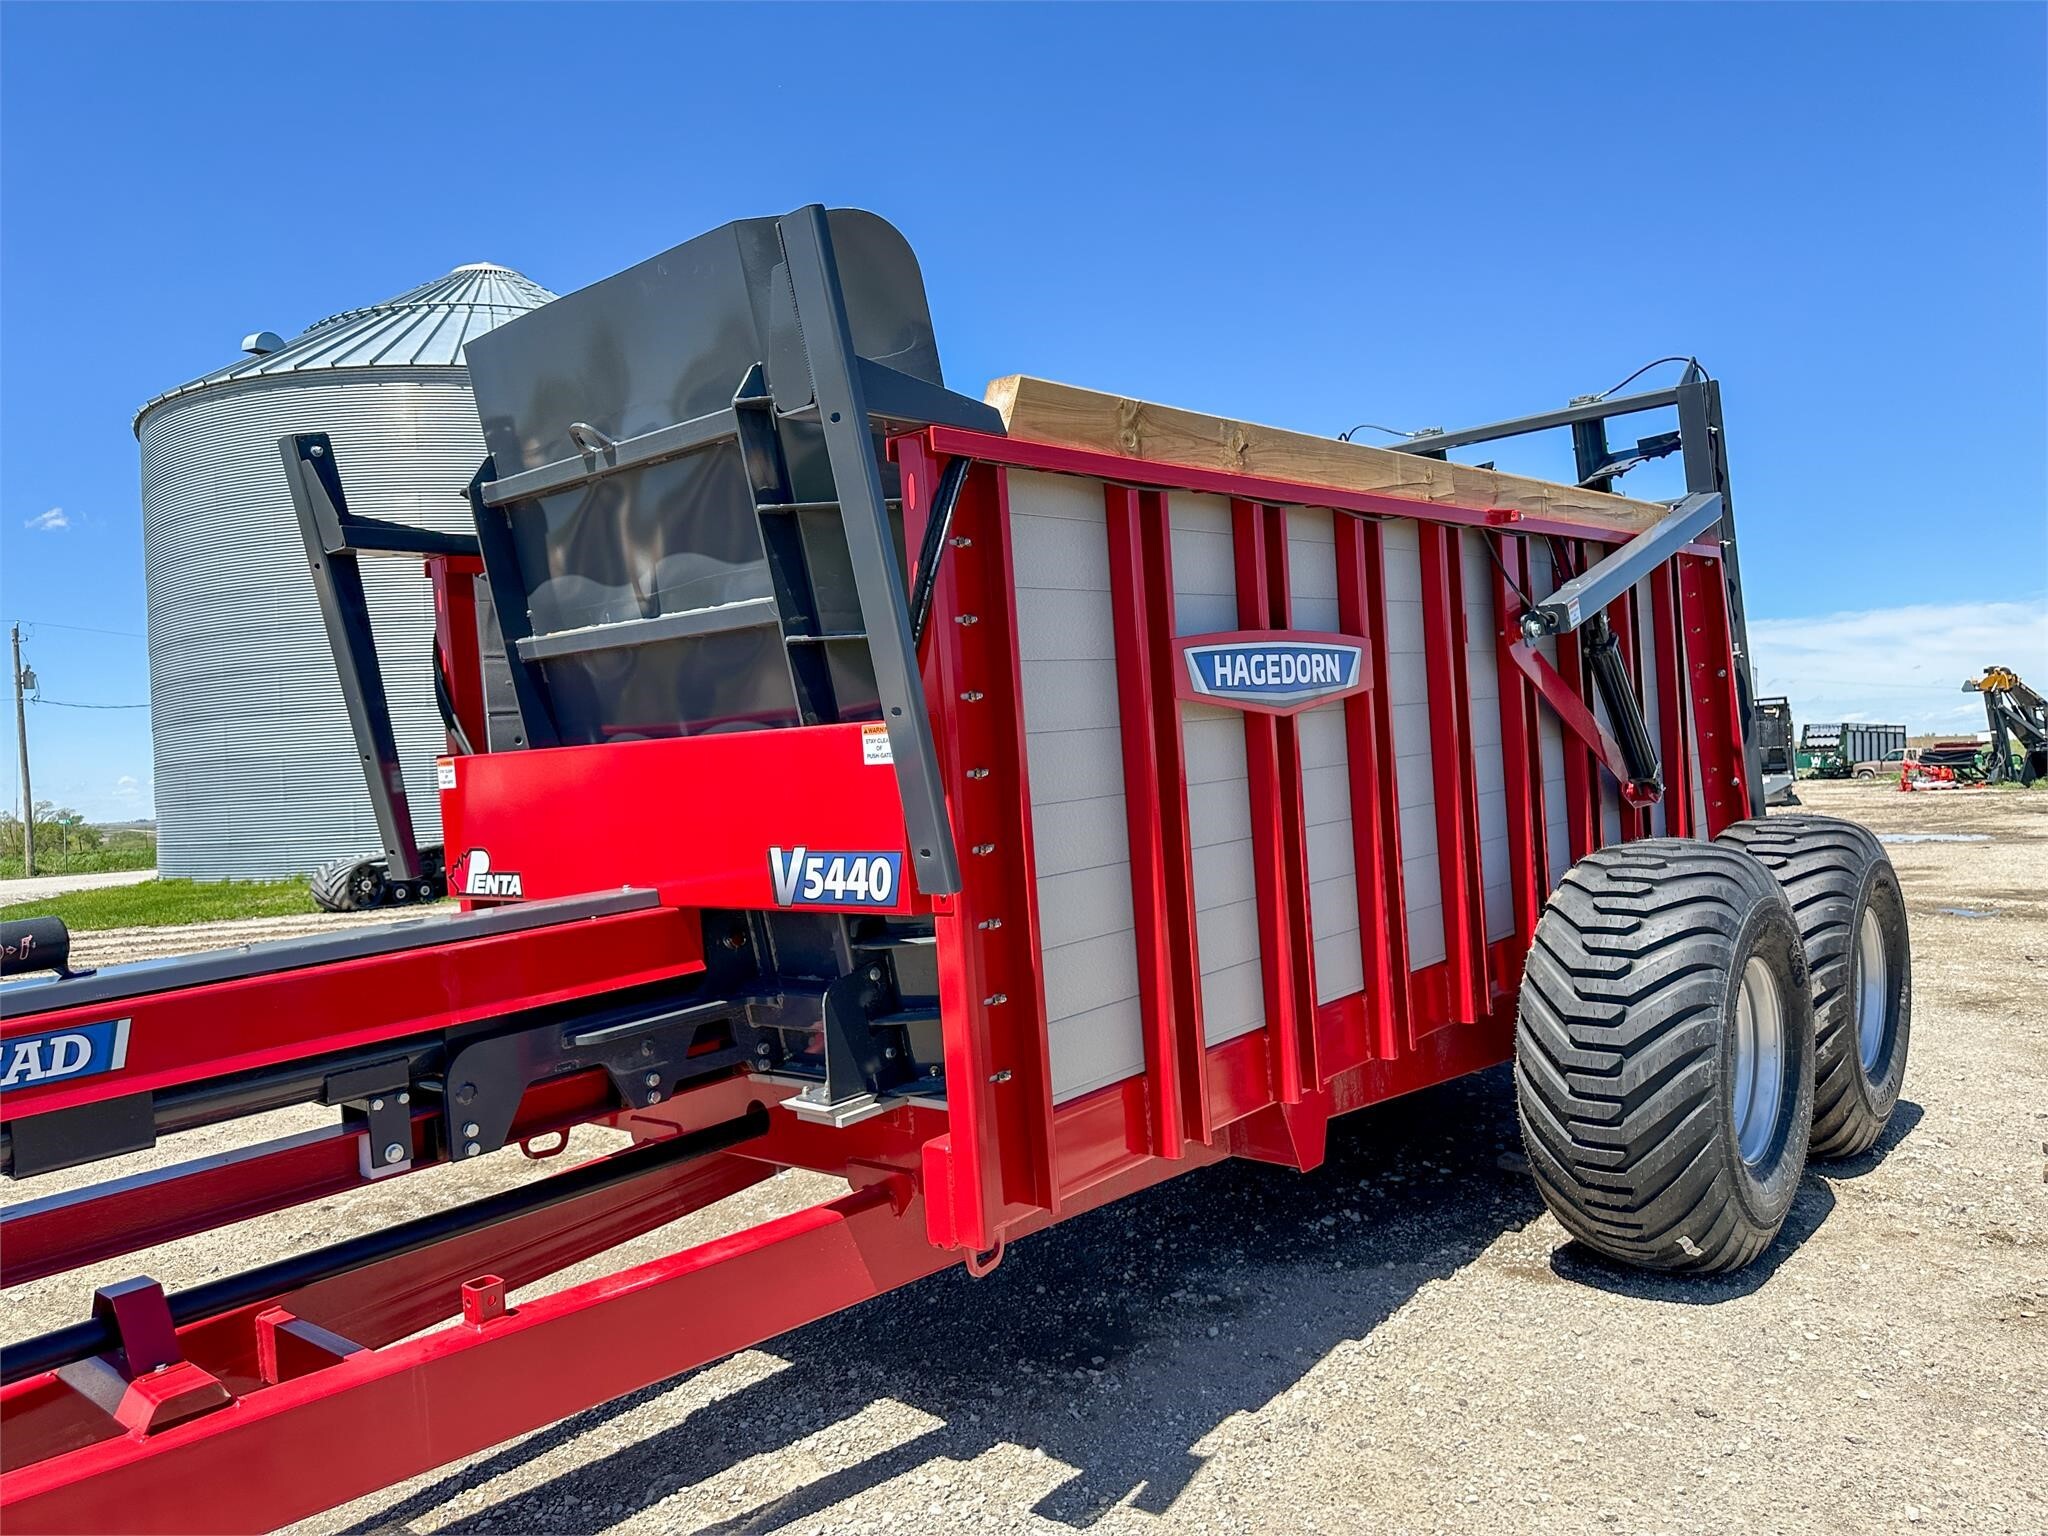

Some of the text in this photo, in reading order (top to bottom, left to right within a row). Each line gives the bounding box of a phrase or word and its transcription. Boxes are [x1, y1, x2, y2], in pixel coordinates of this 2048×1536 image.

[1214, 653, 1341, 687] HAGEDORN
[465, 850, 523, 896] PENTA
[769, 846, 892, 907] V5440
[0, 1034, 92, 1087] AD
